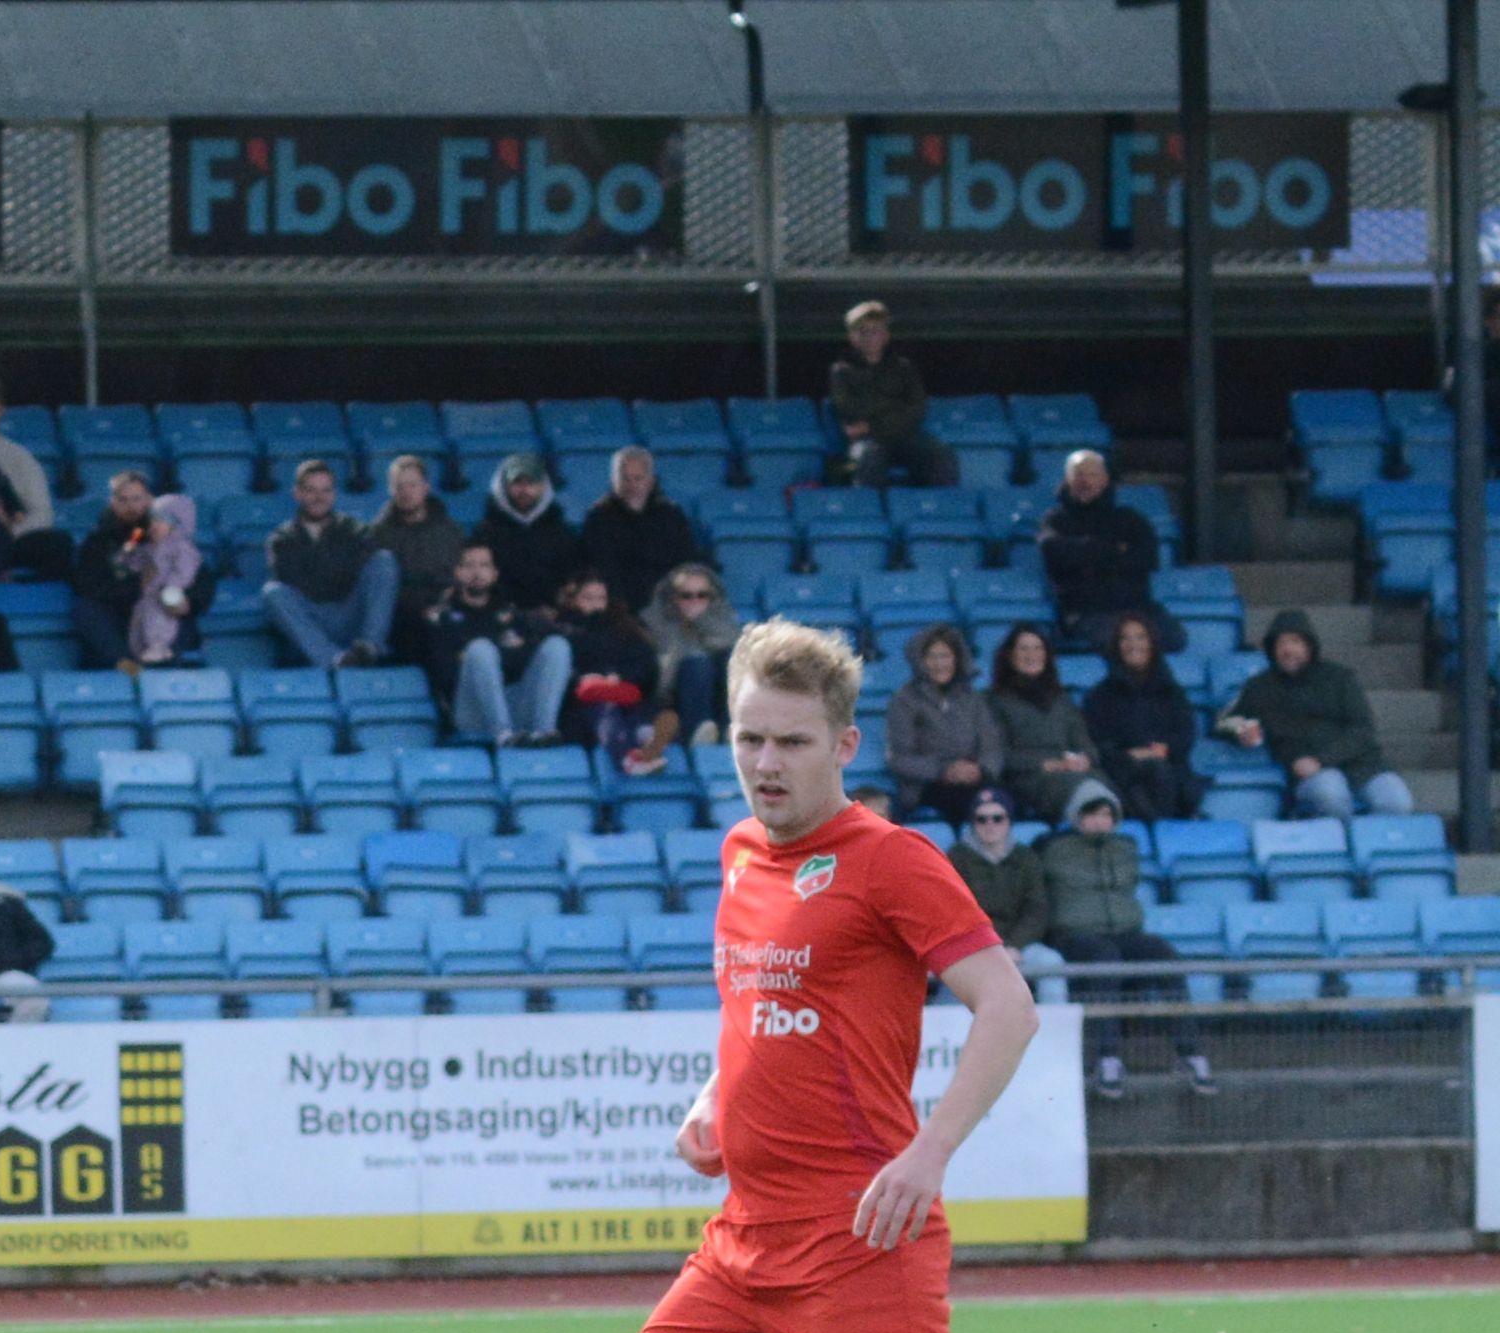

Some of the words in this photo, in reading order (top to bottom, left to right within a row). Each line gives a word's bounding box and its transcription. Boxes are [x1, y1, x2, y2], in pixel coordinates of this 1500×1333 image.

[190, 139, 415, 235] Fibo
[439, 137, 663, 234] Fibo
[866, 134, 1087, 230] Fibo
[750, 1000, 820, 1037] Fibo
[287, 1053, 430, 1092] Nybygg
[476, 1047, 714, 1084] Industribygg
[521, 1222, 561, 1243] ALT
[592, 1218, 632, 1241] TRE
[645, 1216, 675, 1239] OG
